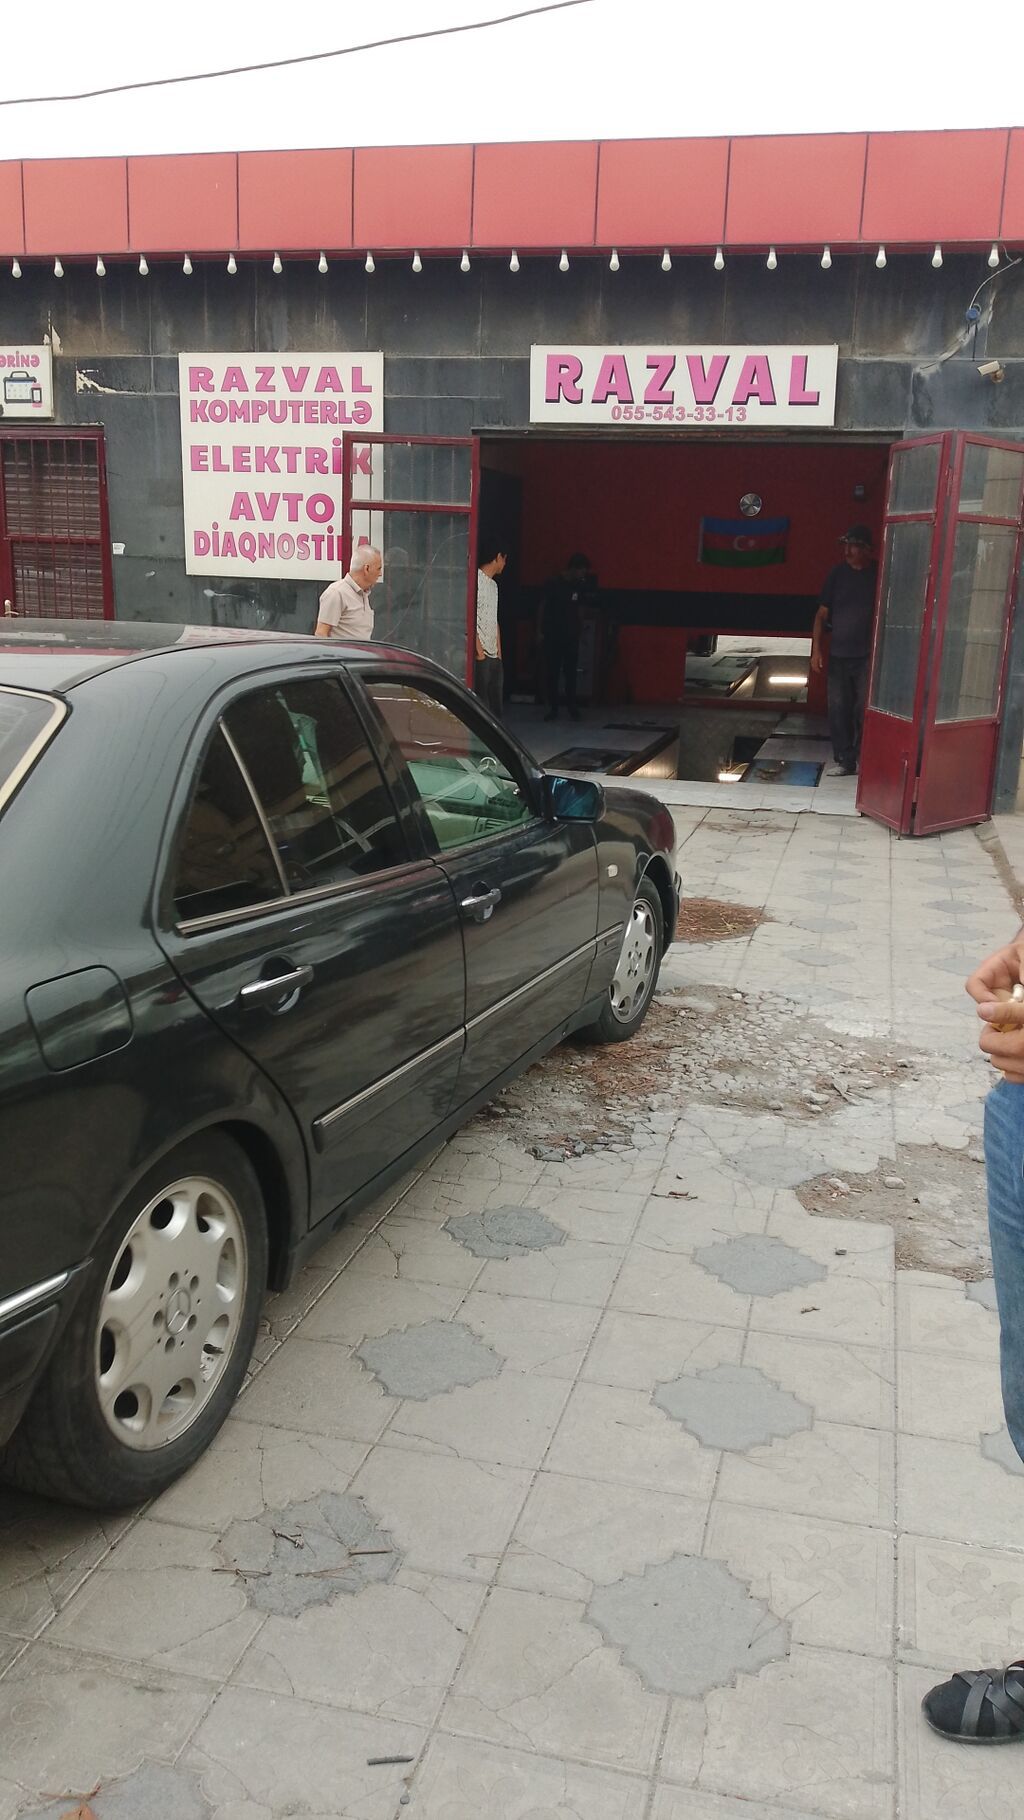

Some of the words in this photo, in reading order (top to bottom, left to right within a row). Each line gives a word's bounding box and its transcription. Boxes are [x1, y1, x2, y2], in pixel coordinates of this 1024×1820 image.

[188, 366, 373, 393] RAZVAL
[545, 354, 820, 406] RAZVAL
[190, 400, 373, 424] KOMPUTERLƏ
[611, 405, 747, 422] 055-543-33-13
[190, 437, 374, 475] ELEKTRİK
[229, 491, 335, 523] AVTO
